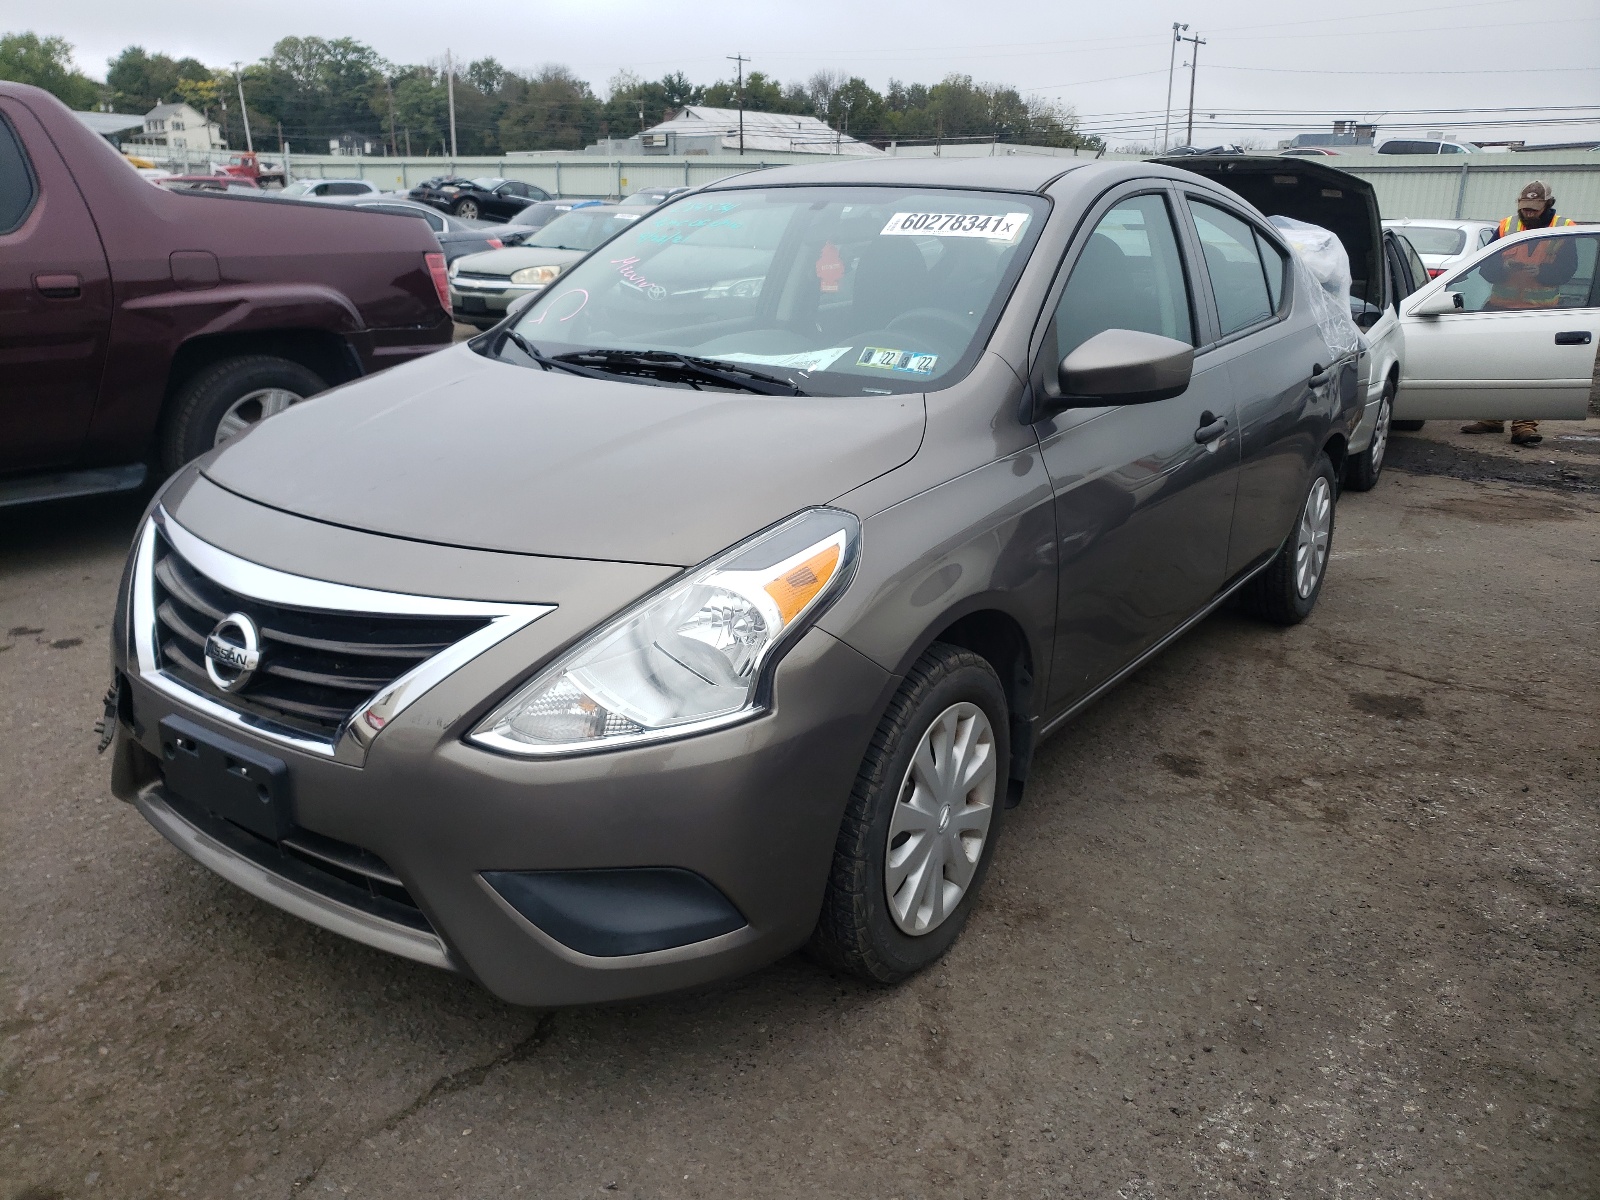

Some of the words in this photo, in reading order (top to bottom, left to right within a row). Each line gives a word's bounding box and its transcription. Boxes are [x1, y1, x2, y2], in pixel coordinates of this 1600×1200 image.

[881, 352, 895, 365] 22
[918, 356, 932, 371] 22
[208, 642, 248, 666] SSAN
